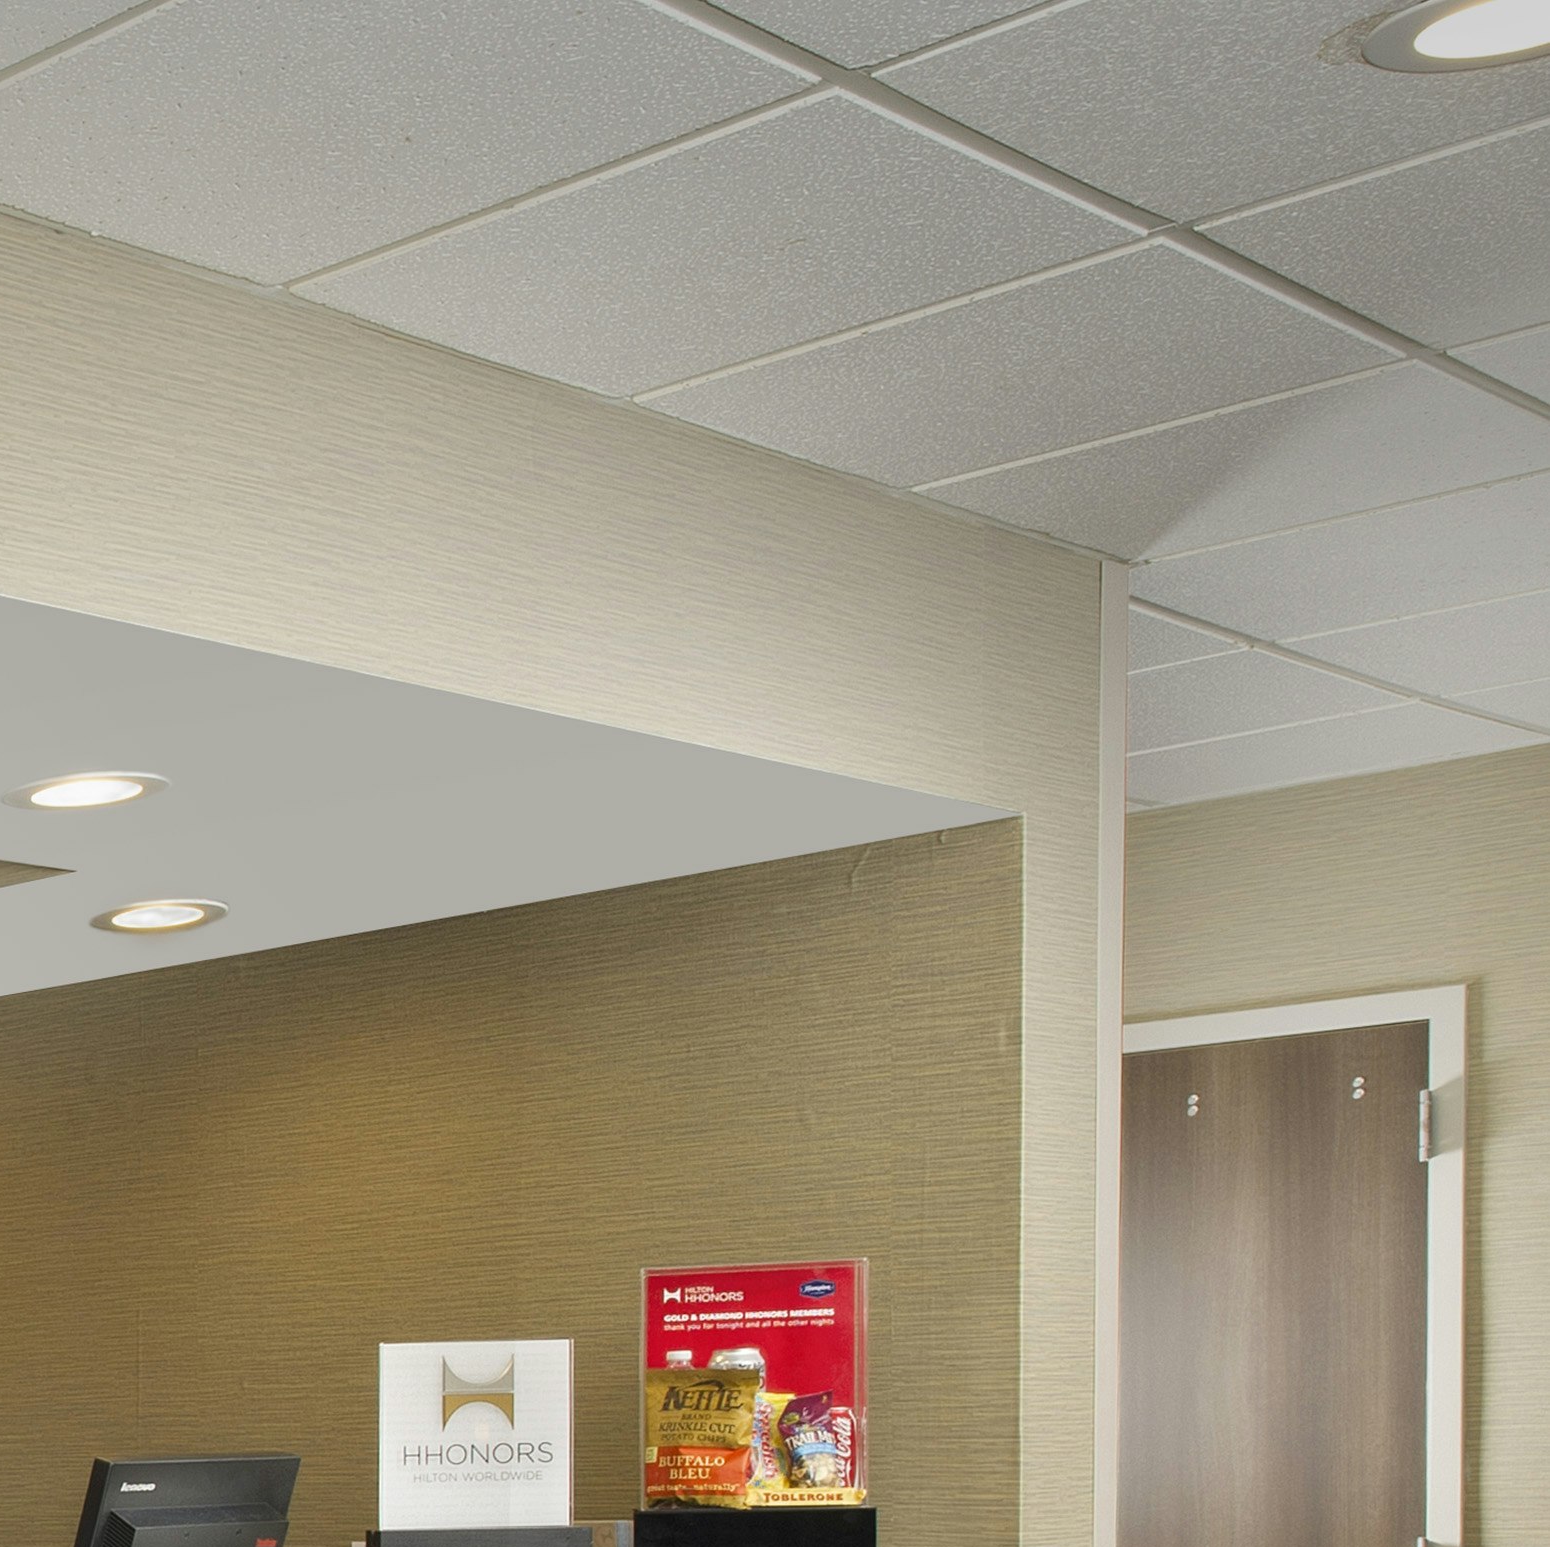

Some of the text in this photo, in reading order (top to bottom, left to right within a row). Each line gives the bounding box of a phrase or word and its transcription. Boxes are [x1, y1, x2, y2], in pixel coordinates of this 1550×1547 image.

[684, 1286, 714, 1294] HILTON
[684, 1291, 744, 1303] HHONORS
[664, 1308, 835, 1322] GOLD & DIAMOND HHONORS MEMBERS
[664, 1317, 834, 1332] thank you for tonight and all the other nights
[659, 1380, 744, 1412] KETTLE
[658, 1422, 707, 1433] KRINKLE
[661, 1433, 727, 1443] POTATO CHIPS
[403, 1442, 553, 1465] HHONORS
[658, 1455, 725, 1467] BUFFALO
[413, 1470, 543, 1483] HILTON WORLDWIDE
[669, 1468, 711, 1479] BLEU
[120, 1482, 156, 1492] lenovo
[763, 1493, 843, 1503] TOBLERONE
